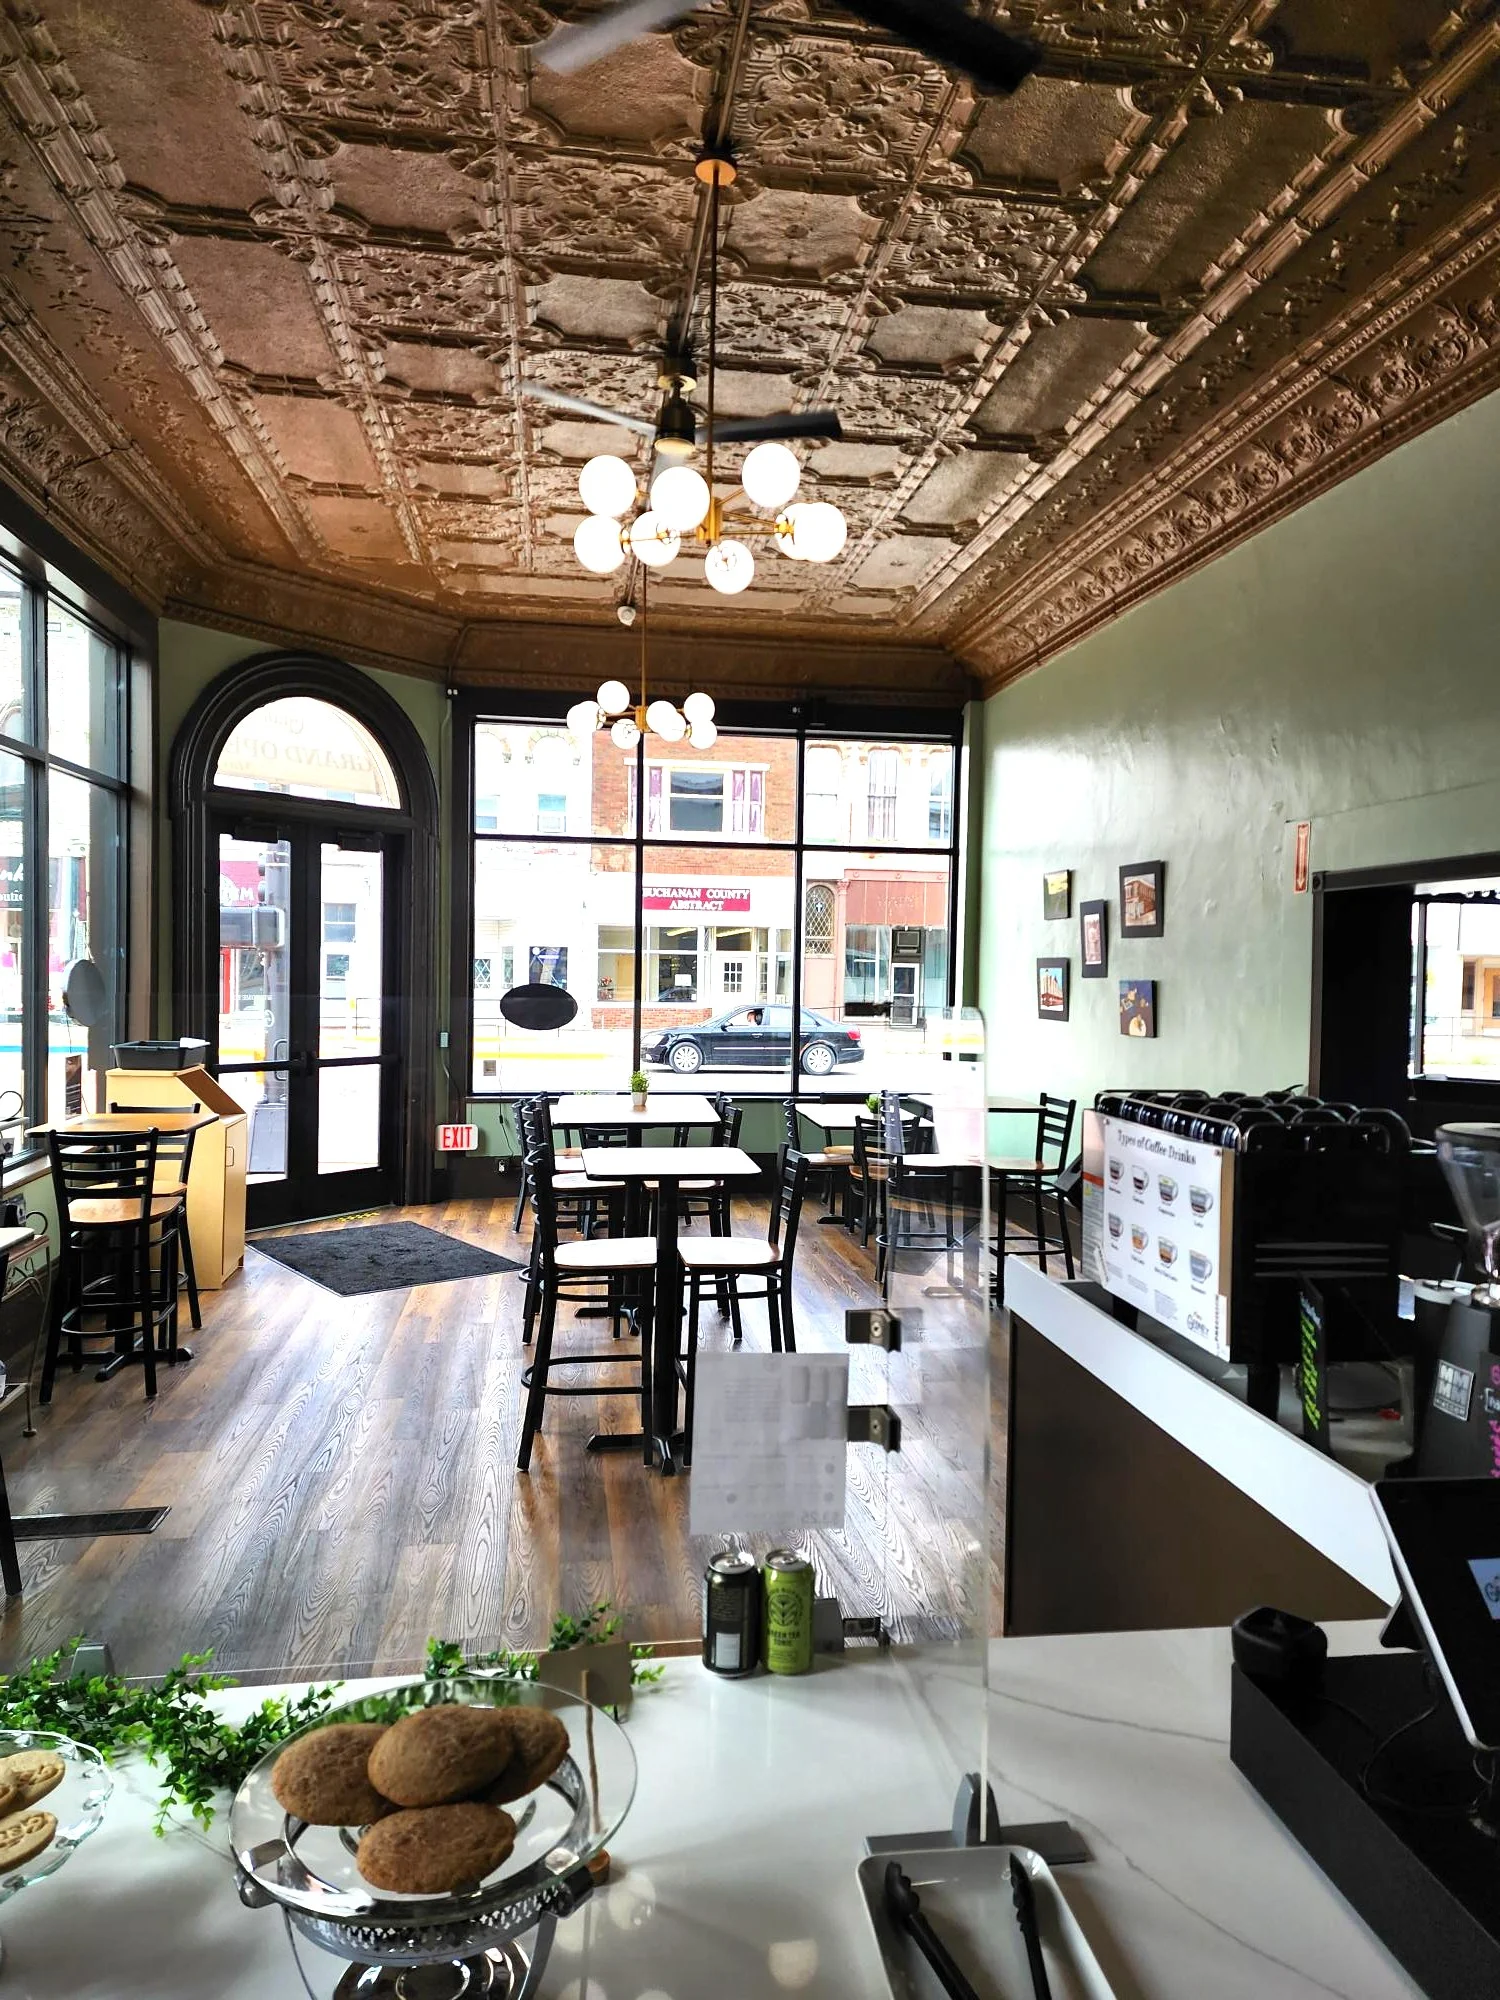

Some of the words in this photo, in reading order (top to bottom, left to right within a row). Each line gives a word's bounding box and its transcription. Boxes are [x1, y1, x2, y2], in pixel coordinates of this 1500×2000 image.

[706, 889, 750, 900] COUNTY
[669, 900, 723, 911] ABSTRACT
[443, 1126, 472, 1149] EXIT
[1117, 1129, 1136, 1147] Types
[1137, 1136, 1145, 1147] of
[1145, 1138, 1167, 1156] Coffee
[1168, 1145, 1197, 1165] Drinks
